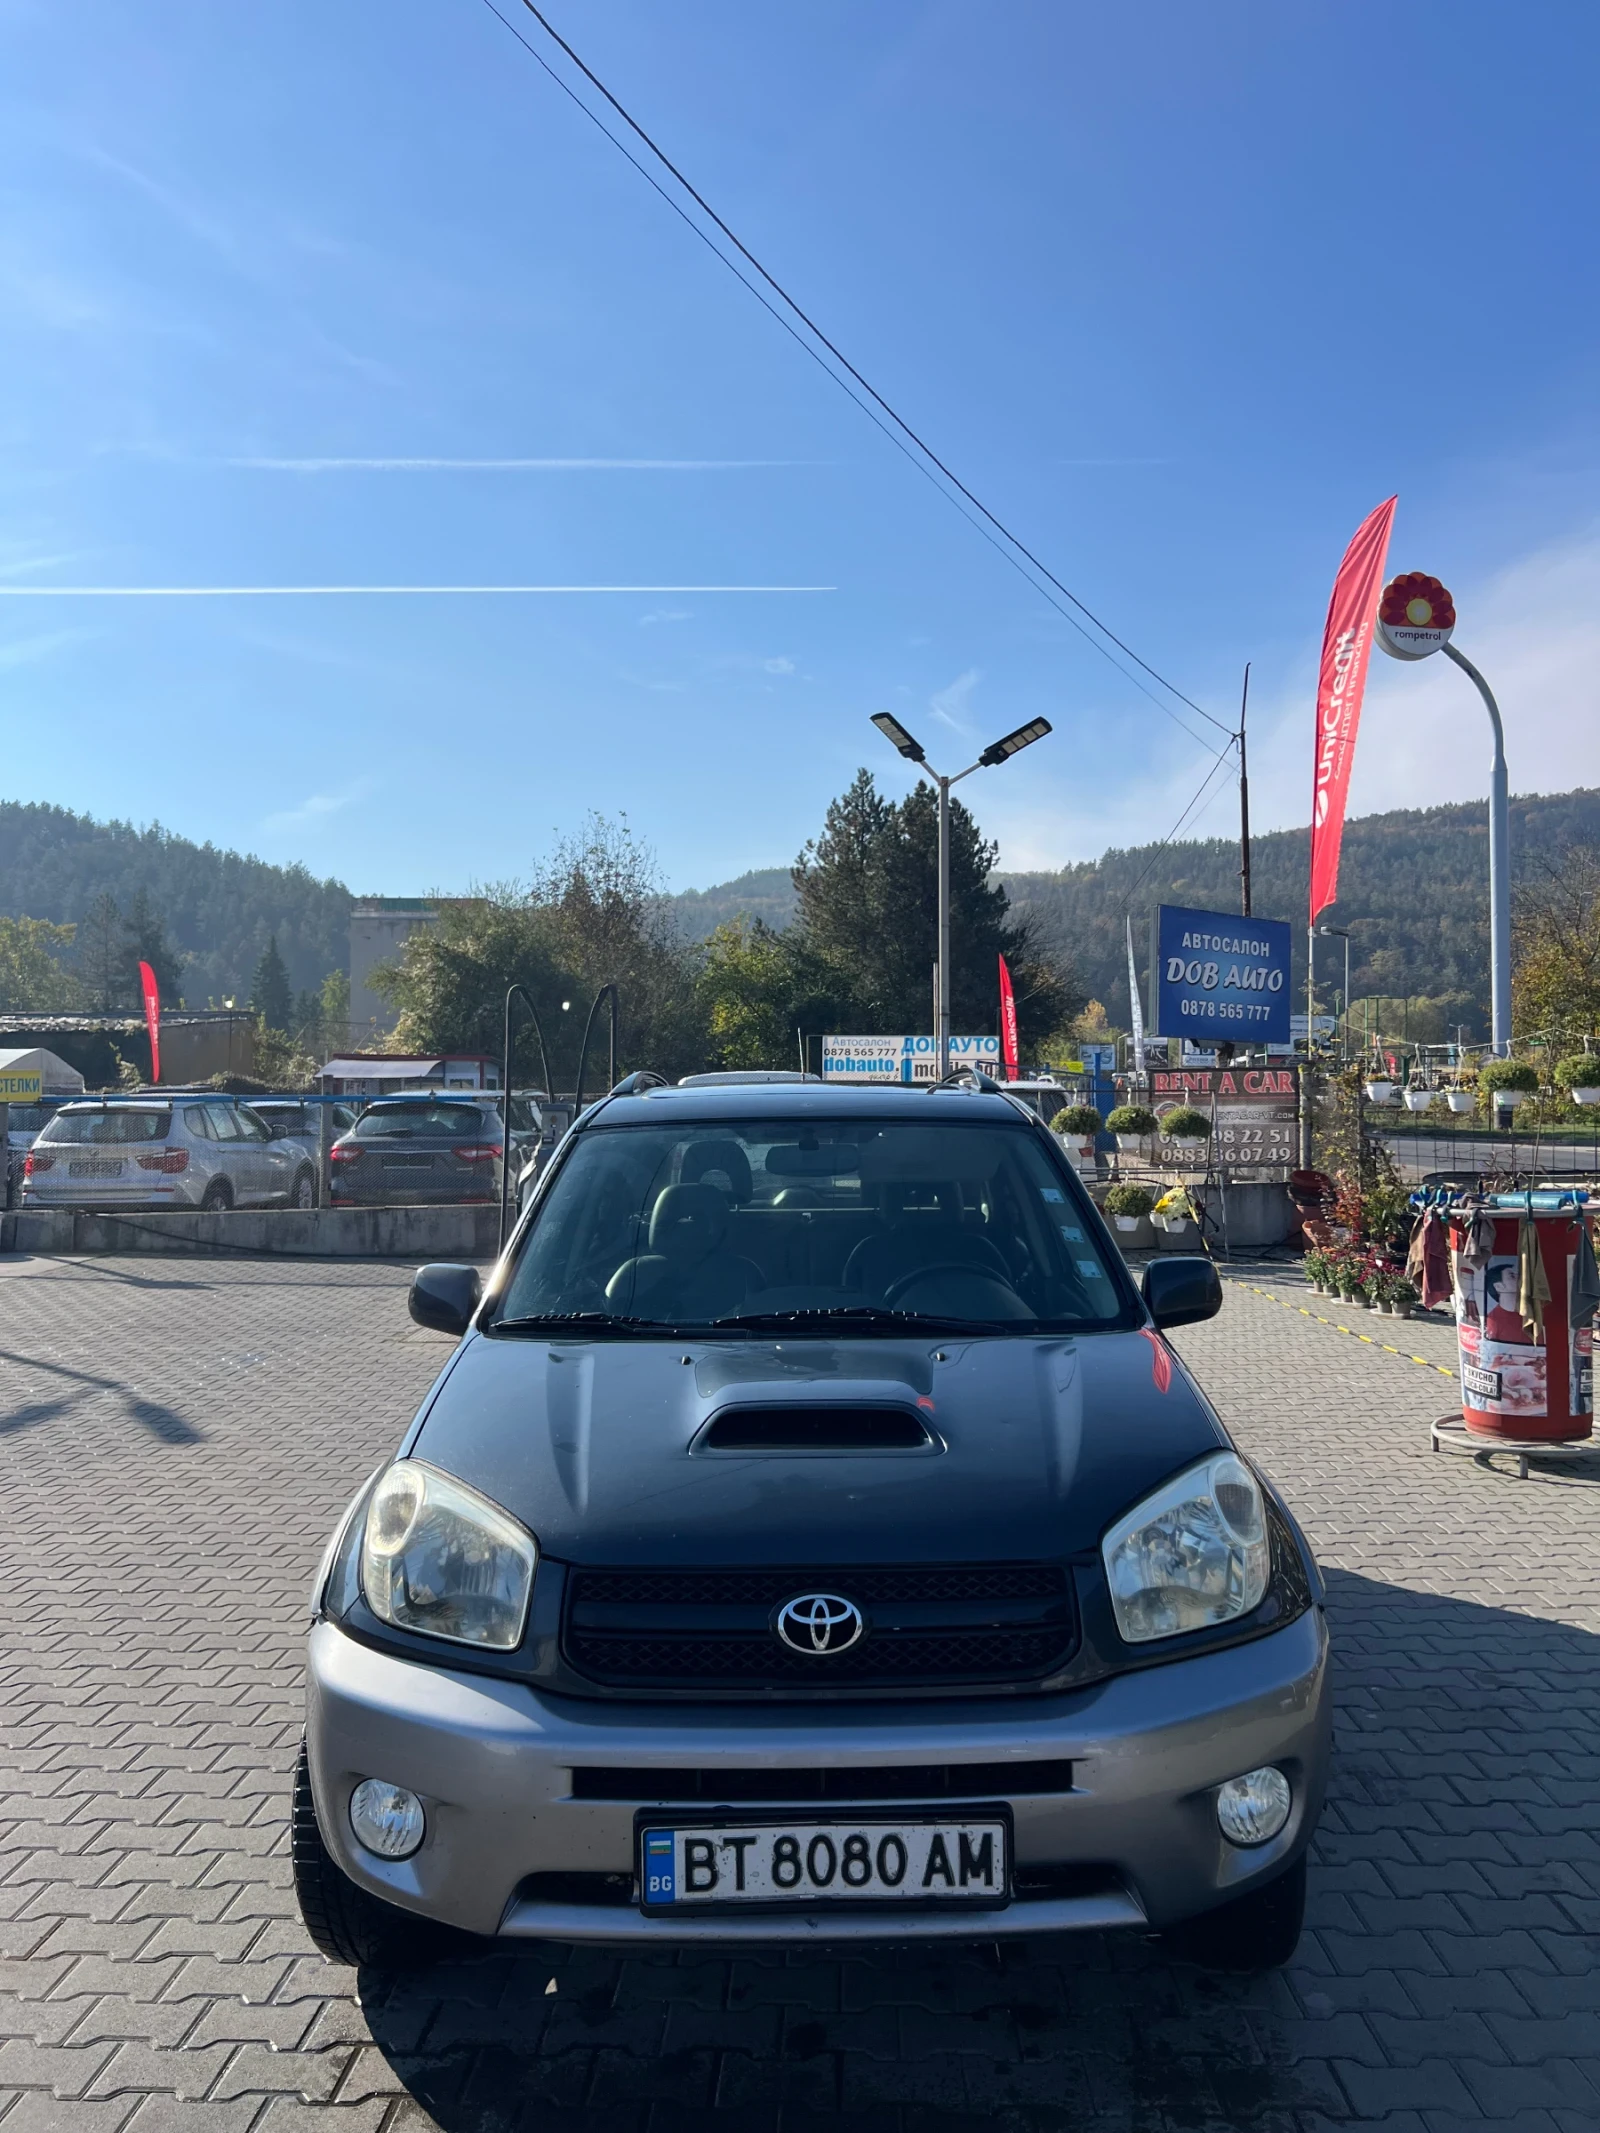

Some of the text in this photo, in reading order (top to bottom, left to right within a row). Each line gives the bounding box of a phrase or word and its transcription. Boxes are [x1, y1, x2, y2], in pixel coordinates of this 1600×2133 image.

[1395, 631, 1441, 641] rompetrol
[1346, 621, 1369, 697] Financing
[1317, 627, 1356, 785] UniCredit
[1182, 932, 1270, 957] АВТОСАЛОН
[1166, 957, 1283, 991] DOB AUTO
[1181, 999, 1271, 1020] 0878 565 777
[824, 1048, 897, 1056] 0878 565 777
[948, 1037, 998, 1052] АУТО
[1154, 1071, 1296, 1094] RENT A CAR
[1240, 1129, 1264, 1143] 22
[1269, 1129, 1291, 1143] 51
[1161, 1148, 1207, 1162] 0883
[1240, 1147, 1263, 1161] 07
[1267, 1147, 1291, 1161] 49
[684, 1832, 994, 1892] BT 8080 AM
[649, 1875, 672, 1892] BG
